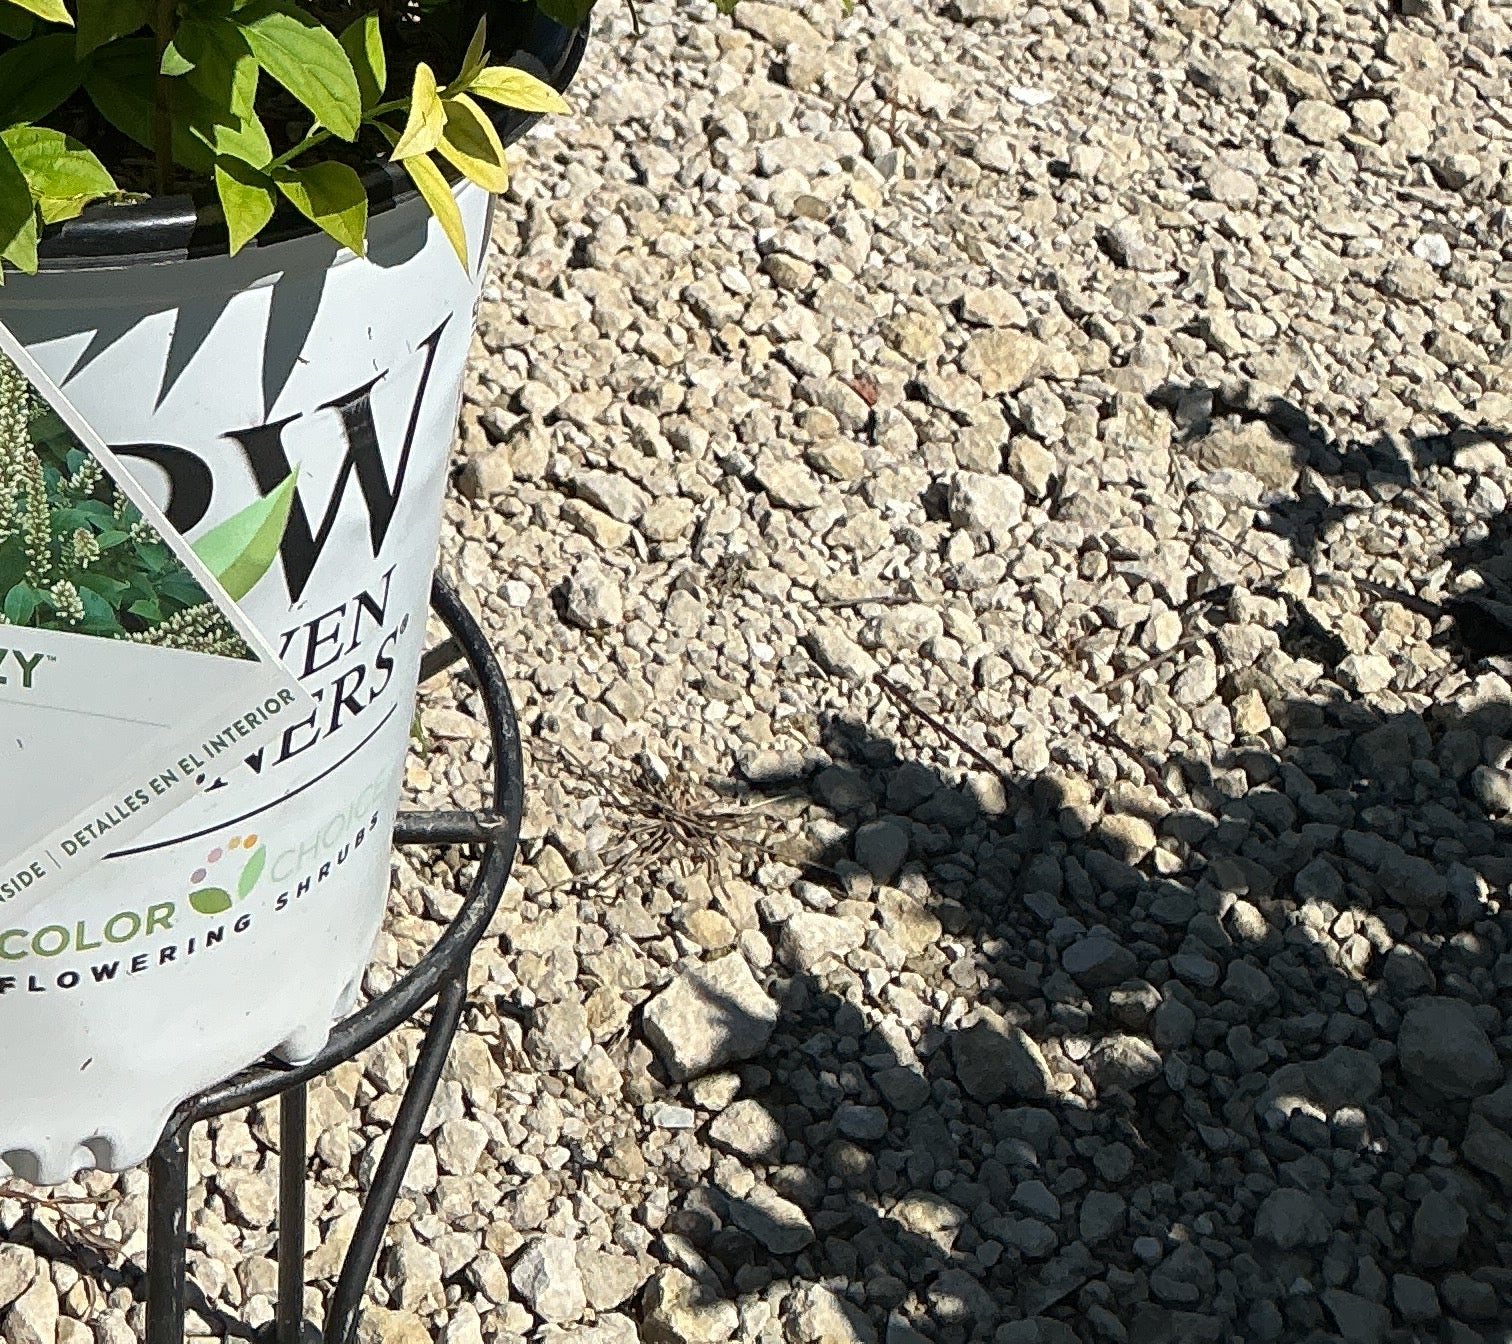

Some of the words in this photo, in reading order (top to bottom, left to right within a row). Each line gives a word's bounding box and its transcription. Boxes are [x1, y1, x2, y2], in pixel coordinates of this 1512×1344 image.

[60, 789, 150, 857] DETALLES
[148, 768, 180, 796] EN
[177, 753, 204, 774] EL
[201, 688, 296, 760] INTERIOR
[275, 811, 379, 911] SHRUBS
